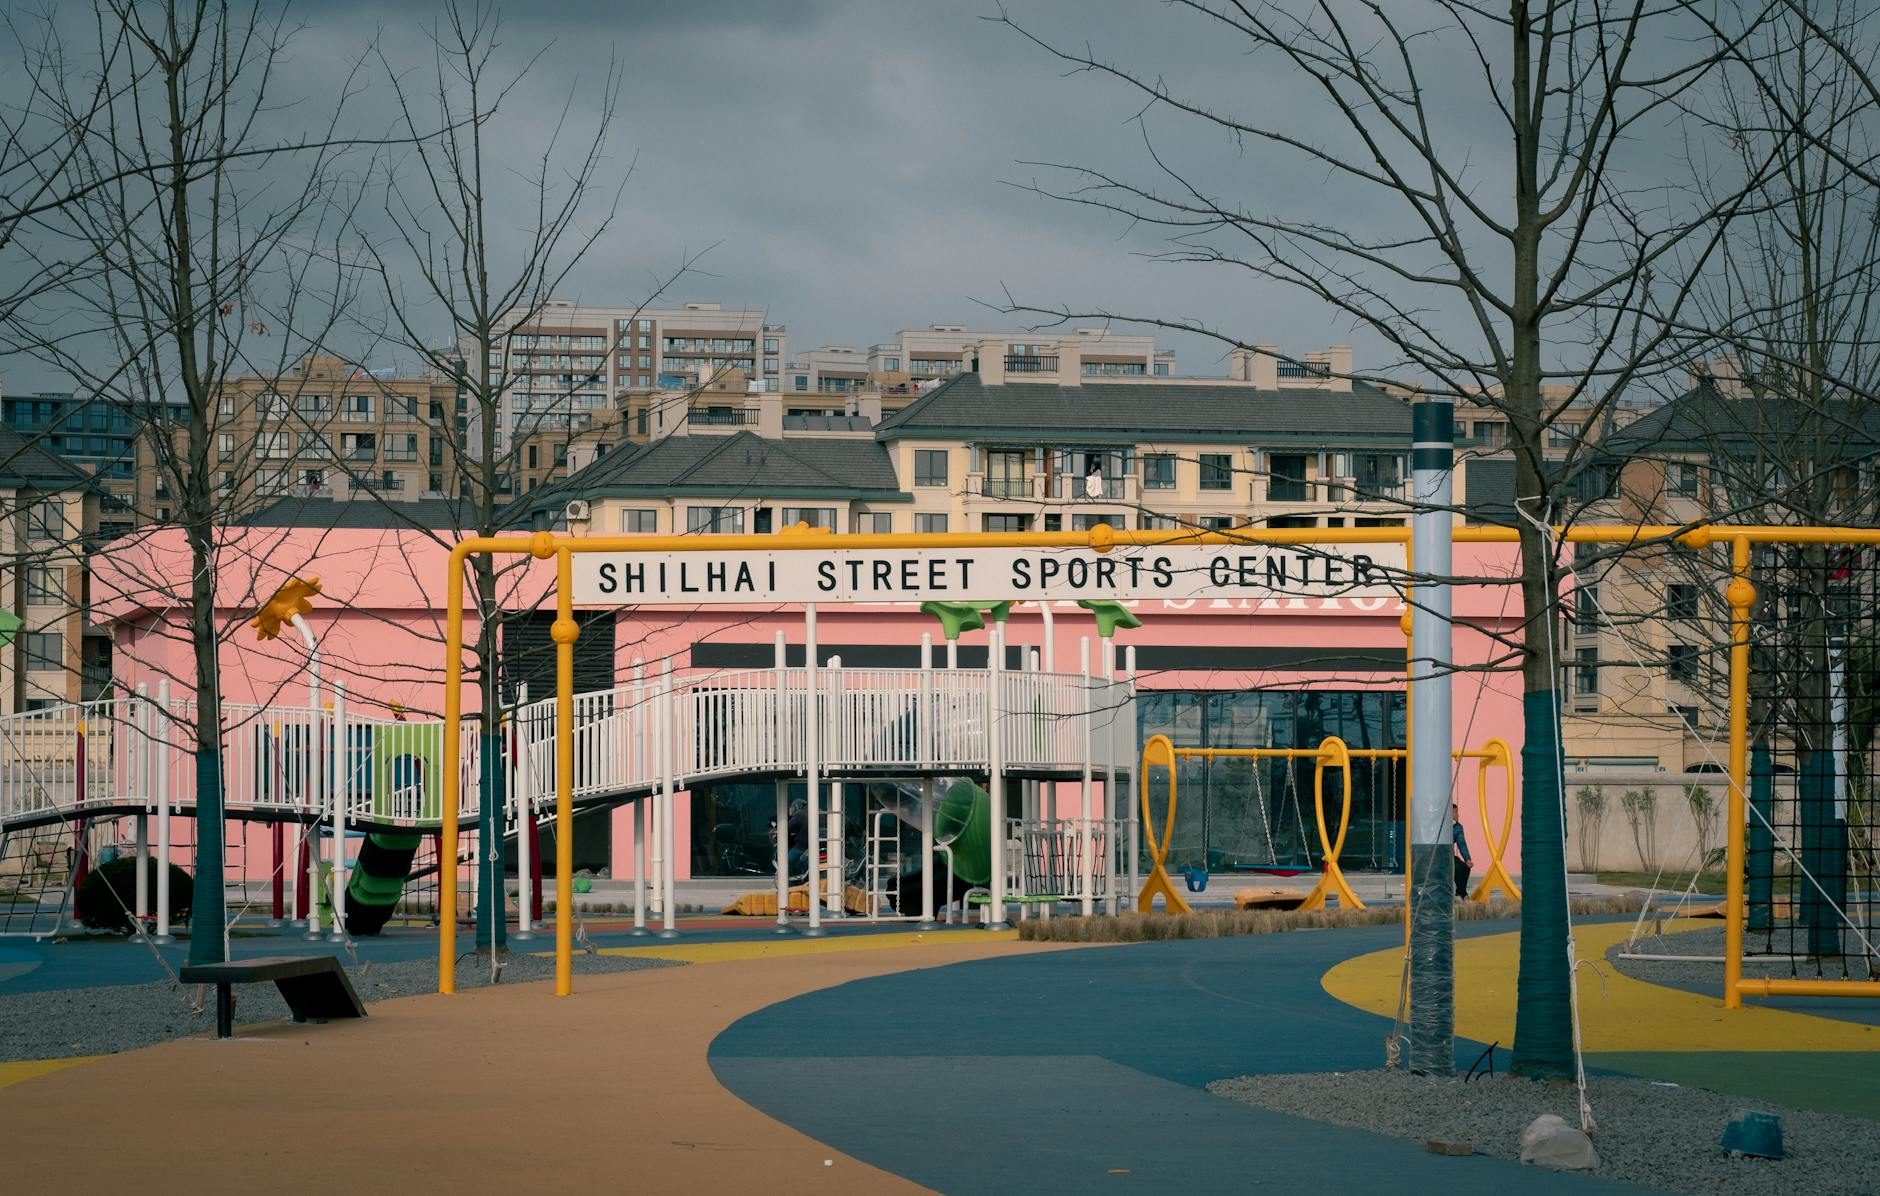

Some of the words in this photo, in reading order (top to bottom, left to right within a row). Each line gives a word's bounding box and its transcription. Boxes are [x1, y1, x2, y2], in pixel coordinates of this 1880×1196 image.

[599, 561, 776, 594] SHILHAI
[817, 558, 975, 592] STREET
[1011, 556, 1174, 590] SPORTS
[1209, 554, 1373, 588] CENTER
